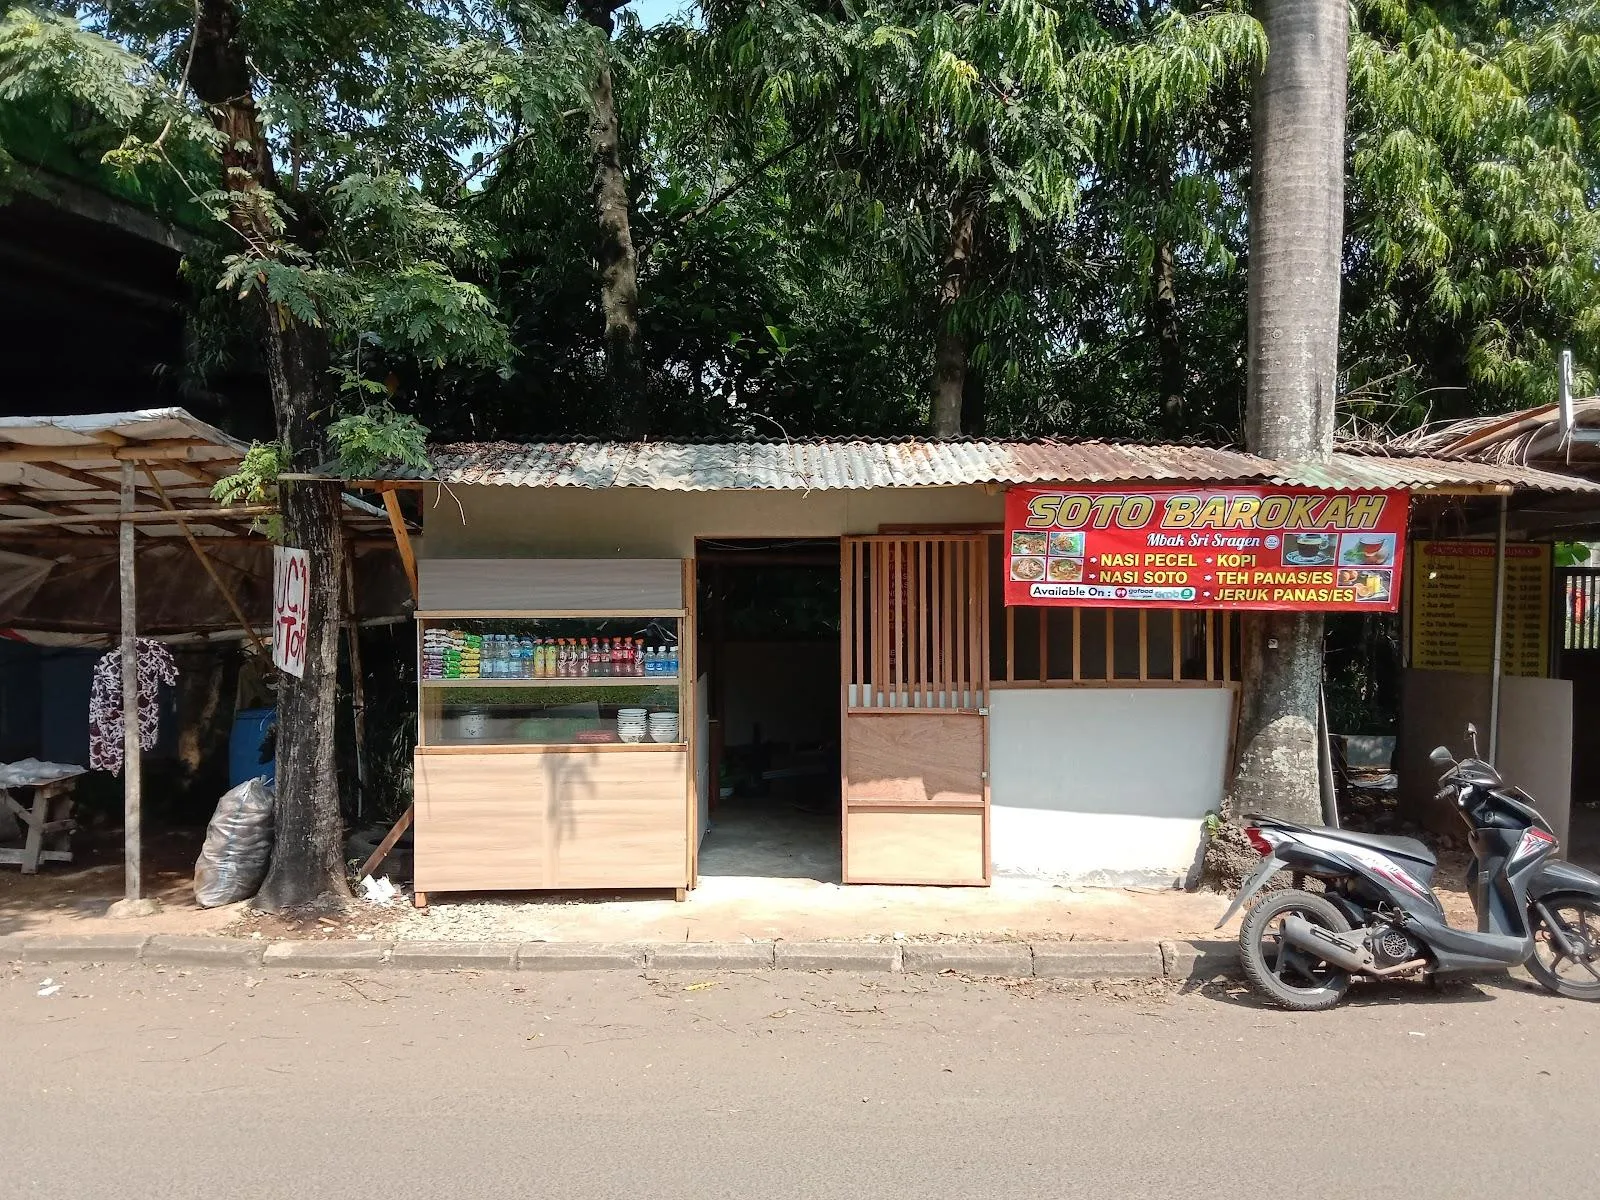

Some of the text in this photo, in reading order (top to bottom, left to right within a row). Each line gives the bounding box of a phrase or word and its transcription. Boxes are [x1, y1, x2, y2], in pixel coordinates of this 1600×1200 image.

[1025, 494, 1389, 530] SOTO BAROKAH
[1147, 533, 1184, 546] Mbak
[1188, 533, 1209, 547] Sri
[1212, 534, 1260, 550] Sragen
[1100, 553, 1198, 567] NASI PECEL
[1217, 554, 1256, 567] KOPI
[1100, 570, 1188, 584] NASI SOTO
[1216, 570, 1334, 585] TEH PANAS/ES
[1033, 586, 1086, 597] Available
[1088, 588, 1104, 596] On
[1214, 588, 1356, 603] JERUK PANAS/ES
